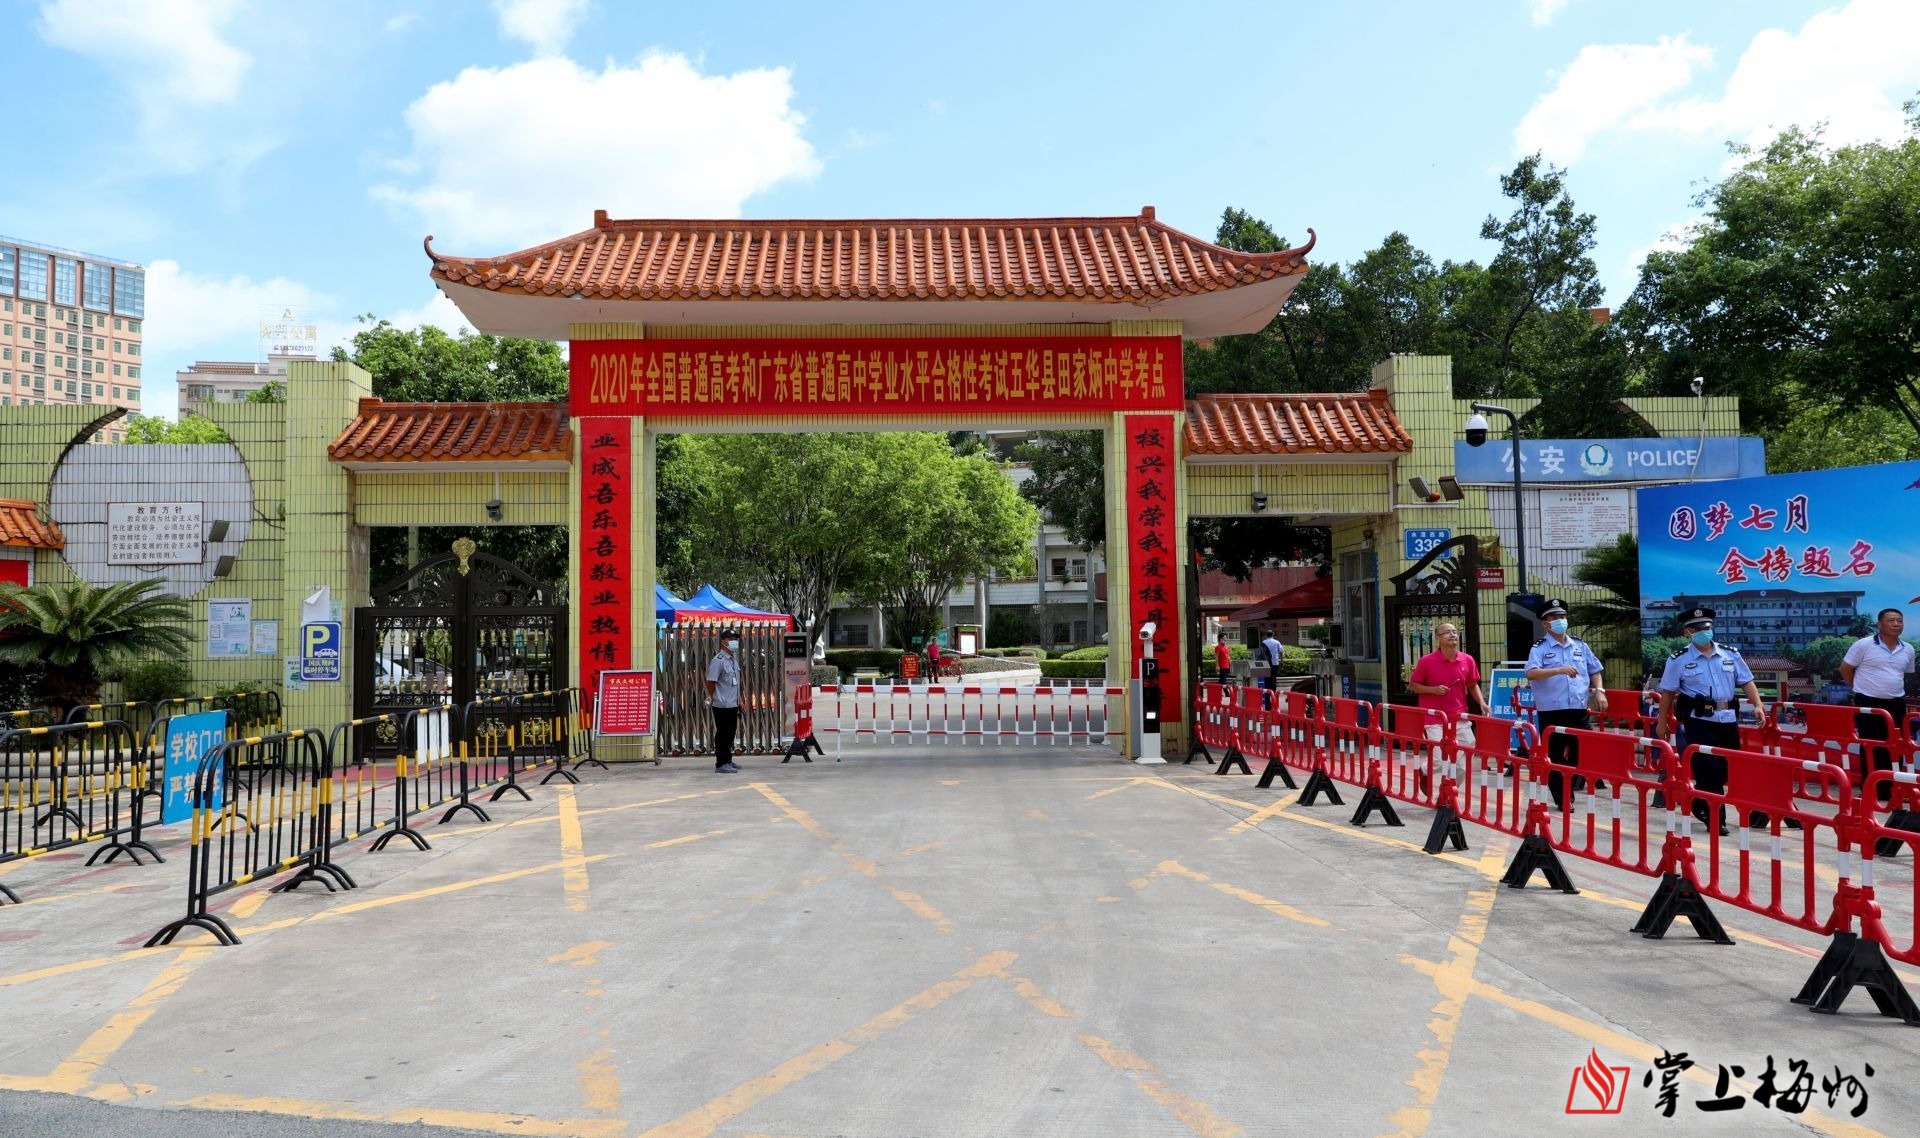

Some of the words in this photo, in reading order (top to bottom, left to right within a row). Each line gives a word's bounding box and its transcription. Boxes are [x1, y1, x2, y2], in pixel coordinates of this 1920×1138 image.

[589, 348, 1165, 404] 2020年全国普通高考和广东省普通高中学业水平合格性考试五华县田家炳中学考点
[1500, 445, 1566, 475] 公安
[1627, 449, 1697, 468] POLICE
[137, 506, 182, 514] 教育方针
[1668, 494, 1809, 542] 圆梦七月
[1717, 541, 1877, 584] 金榜题名
[306, 626, 331, 658] P
[304, 666, 338, 674] 临时停车场
[1146, 662, 1155, 676] P
[1497, 677, 1532, 688] 温馨提
[170, 729, 222, 765] 学校门口
